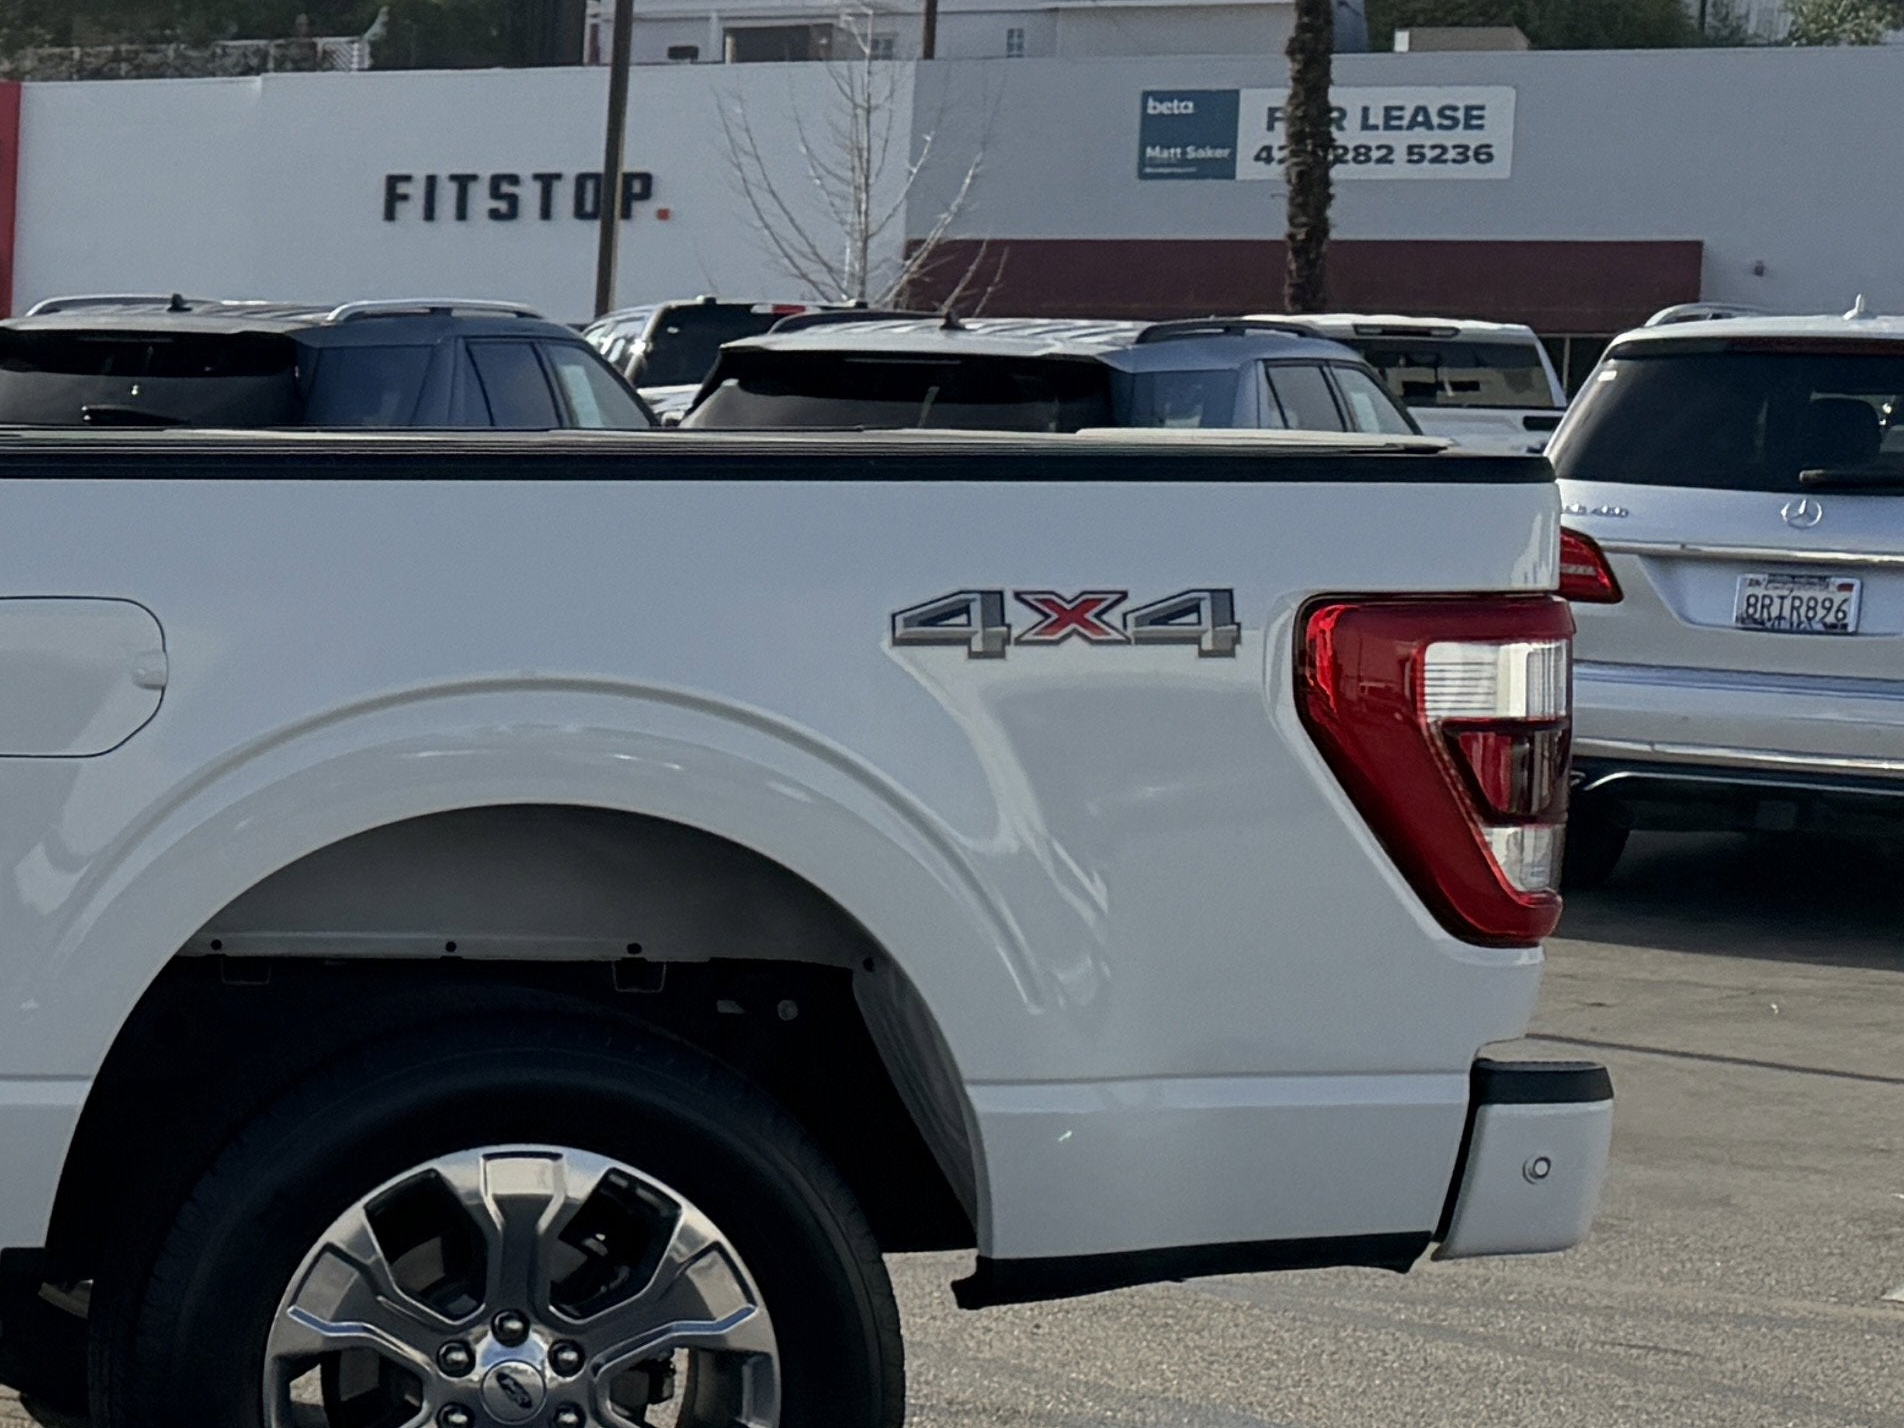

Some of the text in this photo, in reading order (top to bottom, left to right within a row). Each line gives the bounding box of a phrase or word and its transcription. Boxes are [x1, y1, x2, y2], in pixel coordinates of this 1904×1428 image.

[1146, 95, 1194, 115] beta
[1266, 104, 1487, 132] FR LEASE
[1145, 145, 1181, 159] Matt
[1406, 143, 1494, 165] 5236
[1745, 593, 1850, 623] 8RIR896
